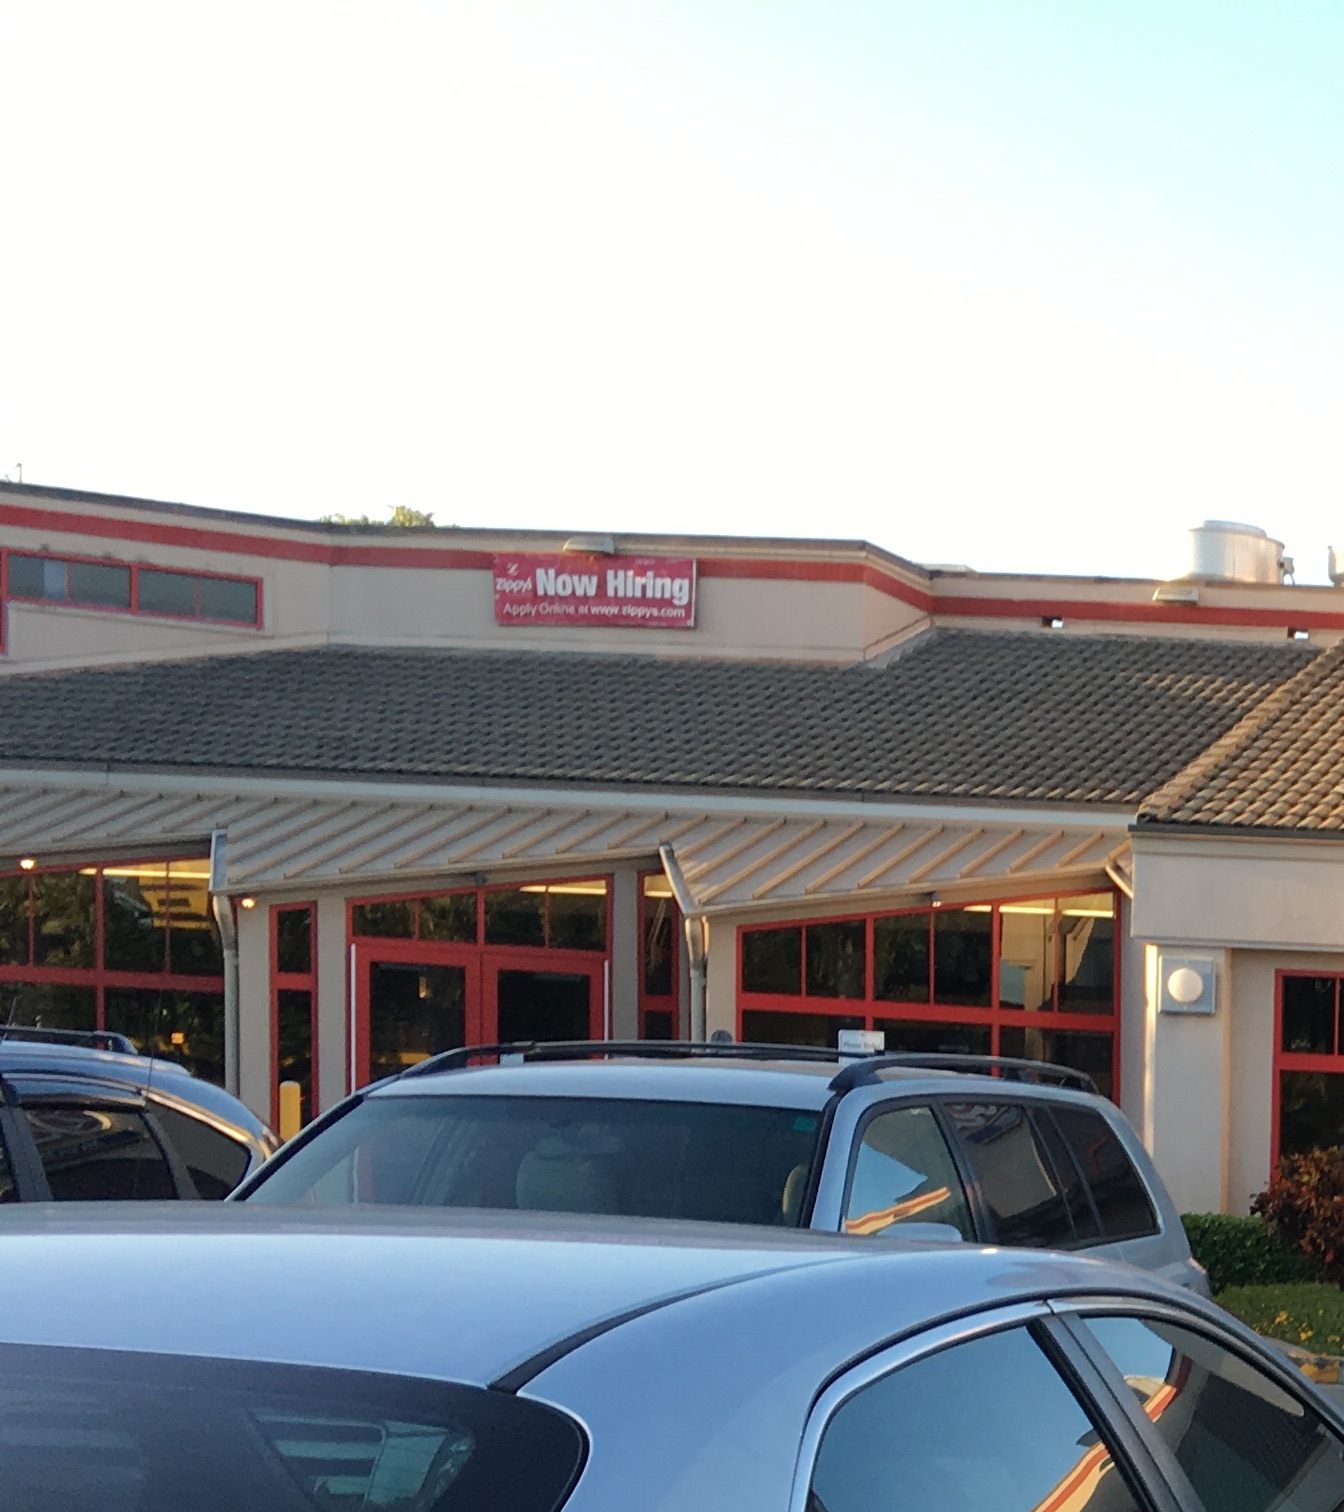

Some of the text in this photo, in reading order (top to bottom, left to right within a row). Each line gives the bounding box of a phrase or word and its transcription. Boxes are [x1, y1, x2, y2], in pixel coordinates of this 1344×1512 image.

[535, 568, 690, 606] Now Hiring
[503, 603, 537, 616] Apply
[539, 604, 576, 615] Online
[578, 604, 589, 615] at
